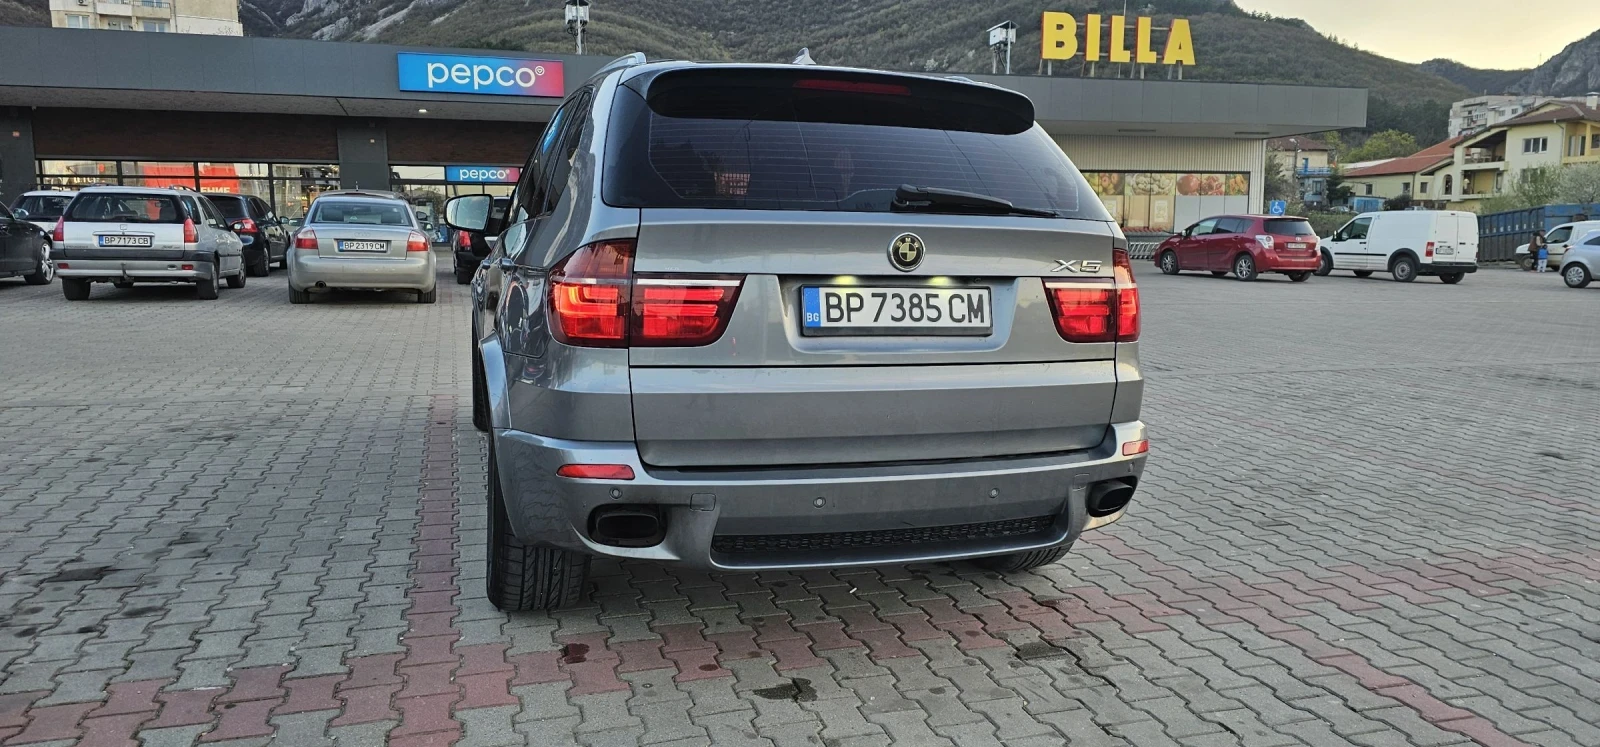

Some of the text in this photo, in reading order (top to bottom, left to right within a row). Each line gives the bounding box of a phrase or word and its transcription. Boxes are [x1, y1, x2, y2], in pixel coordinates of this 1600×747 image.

[1041, 11, 1196, 66] BILLA
[427, 62, 536, 90] pepco
[460, 169, 506, 181] pepco
[117, 236, 137, 245] 7173
[355, 242, 374, 250] 2319
[1050, 259, 1103, 273] X5
[824, 292, 985, 324] BP 7385 CM
[806, 312, 820, 323] BG
